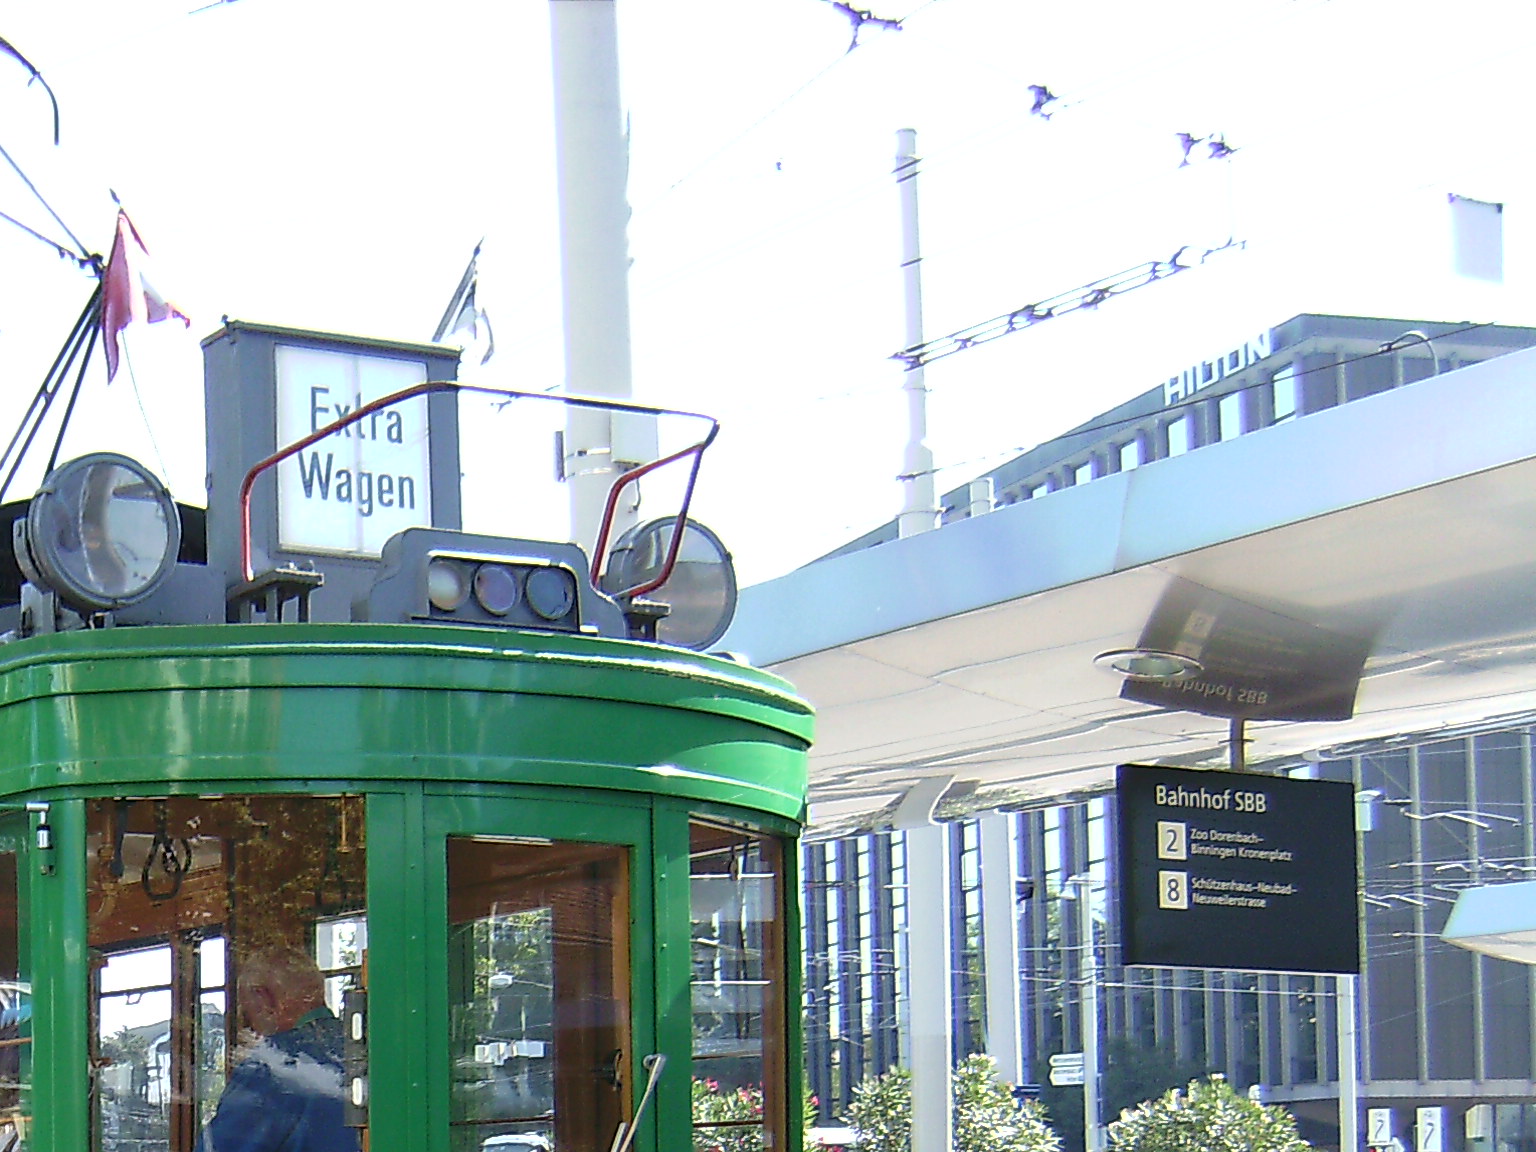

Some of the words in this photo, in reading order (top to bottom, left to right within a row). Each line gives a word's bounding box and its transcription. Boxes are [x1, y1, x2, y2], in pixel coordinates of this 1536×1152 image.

[1164, 328, 1275, 406] HILTON
[311, 386, 403, 444] Extra
[298, 451, 415, 517] Wagen
[1155, 785, 1232, 811] Bahnhof
[1234, 791, 1267, 813] SBB
[1166, 829, 1179, 853] 2
[1190, 828, 1209, 841] Zoo
[1190, 843, 1238, 860] Binningen
[1167, 878, 1180, 903] 8
